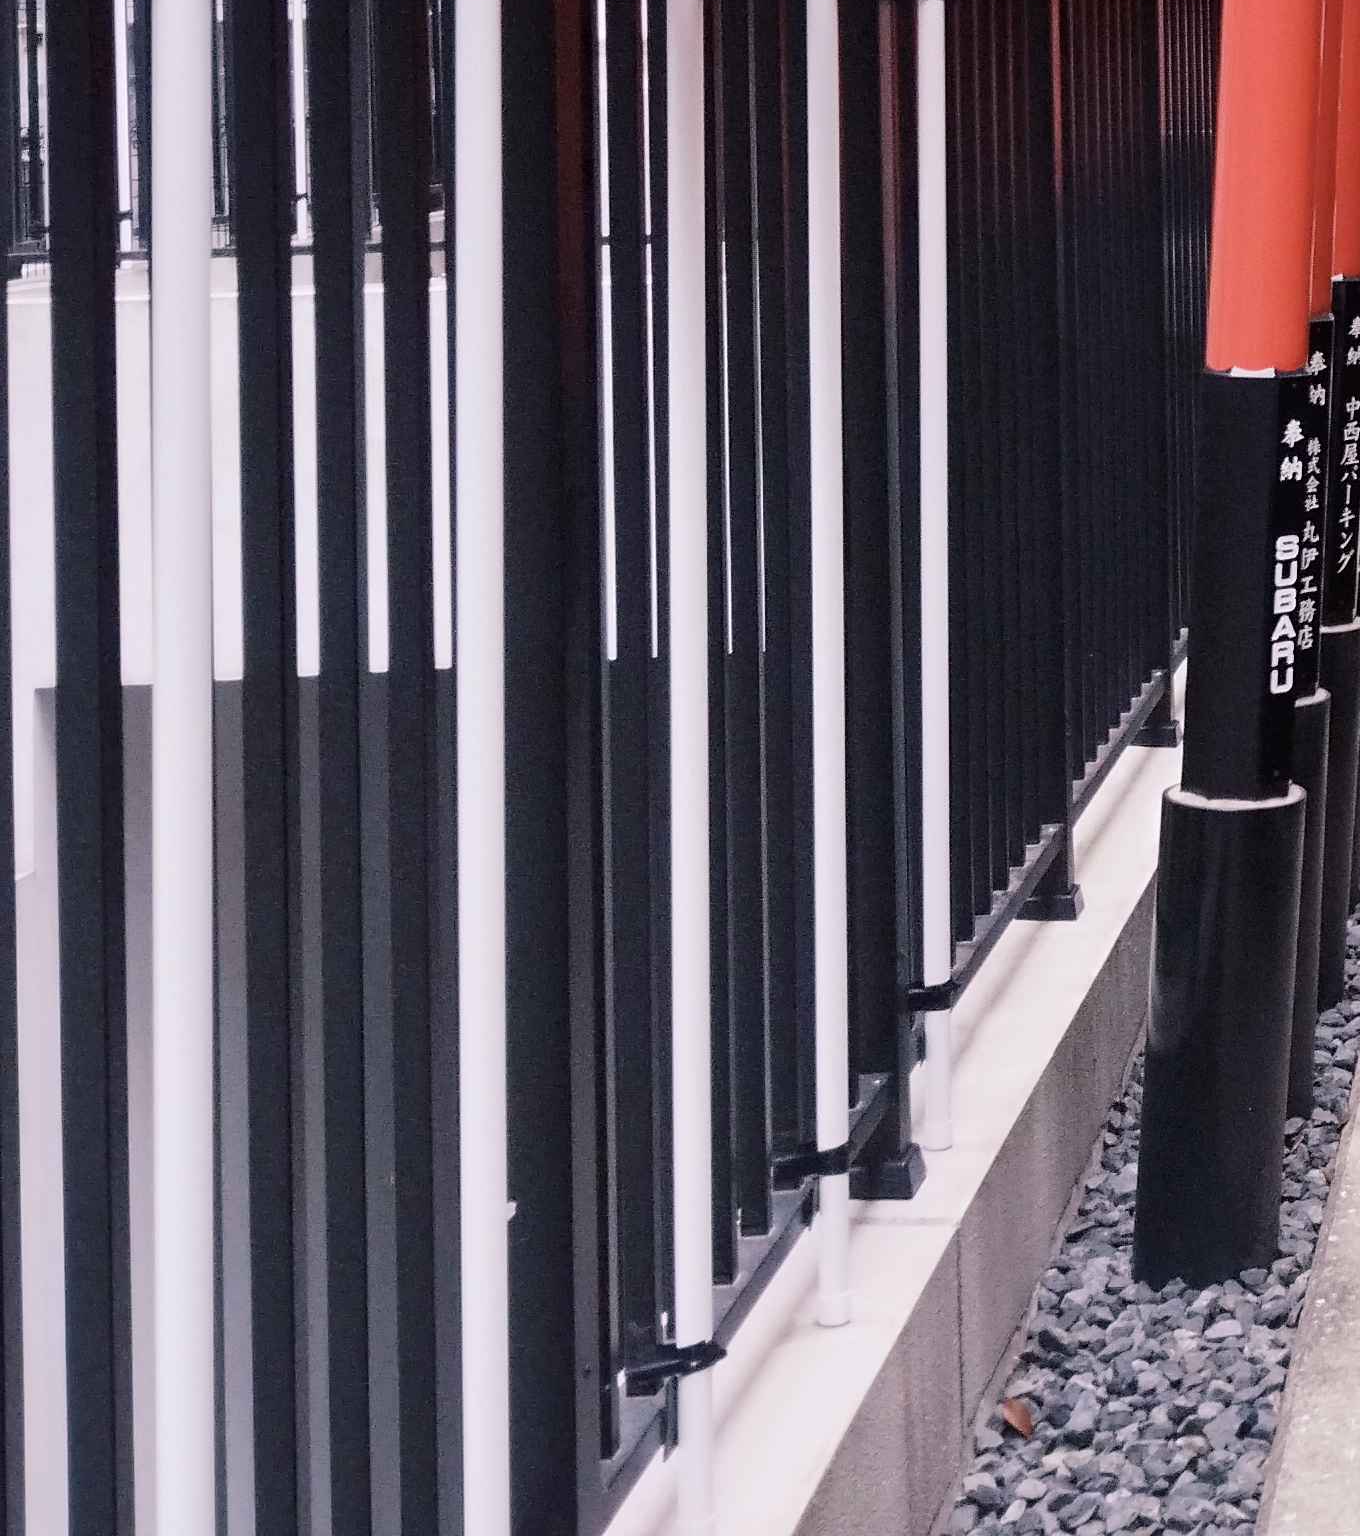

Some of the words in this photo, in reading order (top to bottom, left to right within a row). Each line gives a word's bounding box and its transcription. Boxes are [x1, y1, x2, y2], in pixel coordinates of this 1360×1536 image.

[1307, 348, 1328, 407] 奉納
[1279, 419, 1304, 484] 奉納
[1303, 436, 1322, 511] 株式会社
[1269, 535, 1300, 695] SUBARU
[1297, 519, 1321, 651] 丸伊工務店
